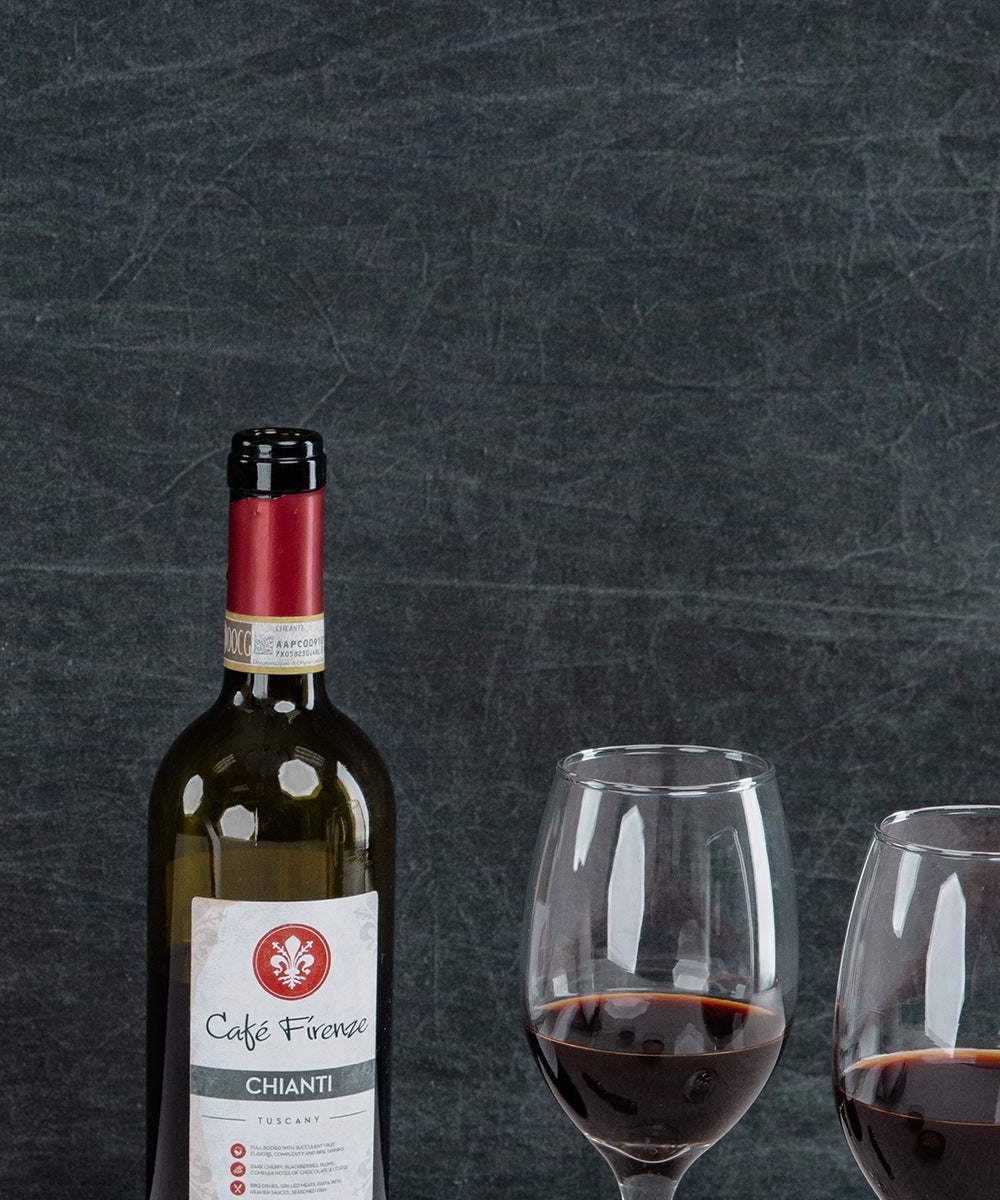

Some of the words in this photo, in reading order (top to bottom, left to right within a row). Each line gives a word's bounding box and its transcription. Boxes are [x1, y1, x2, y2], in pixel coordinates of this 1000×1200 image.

[206, 1011, 271, 1051] Café
[278, 1015, 369, 1041] Firenze
[245, 1075, 333, 1095] CHIANTI
[258, 1115, 321, 1125] TUSCANY
